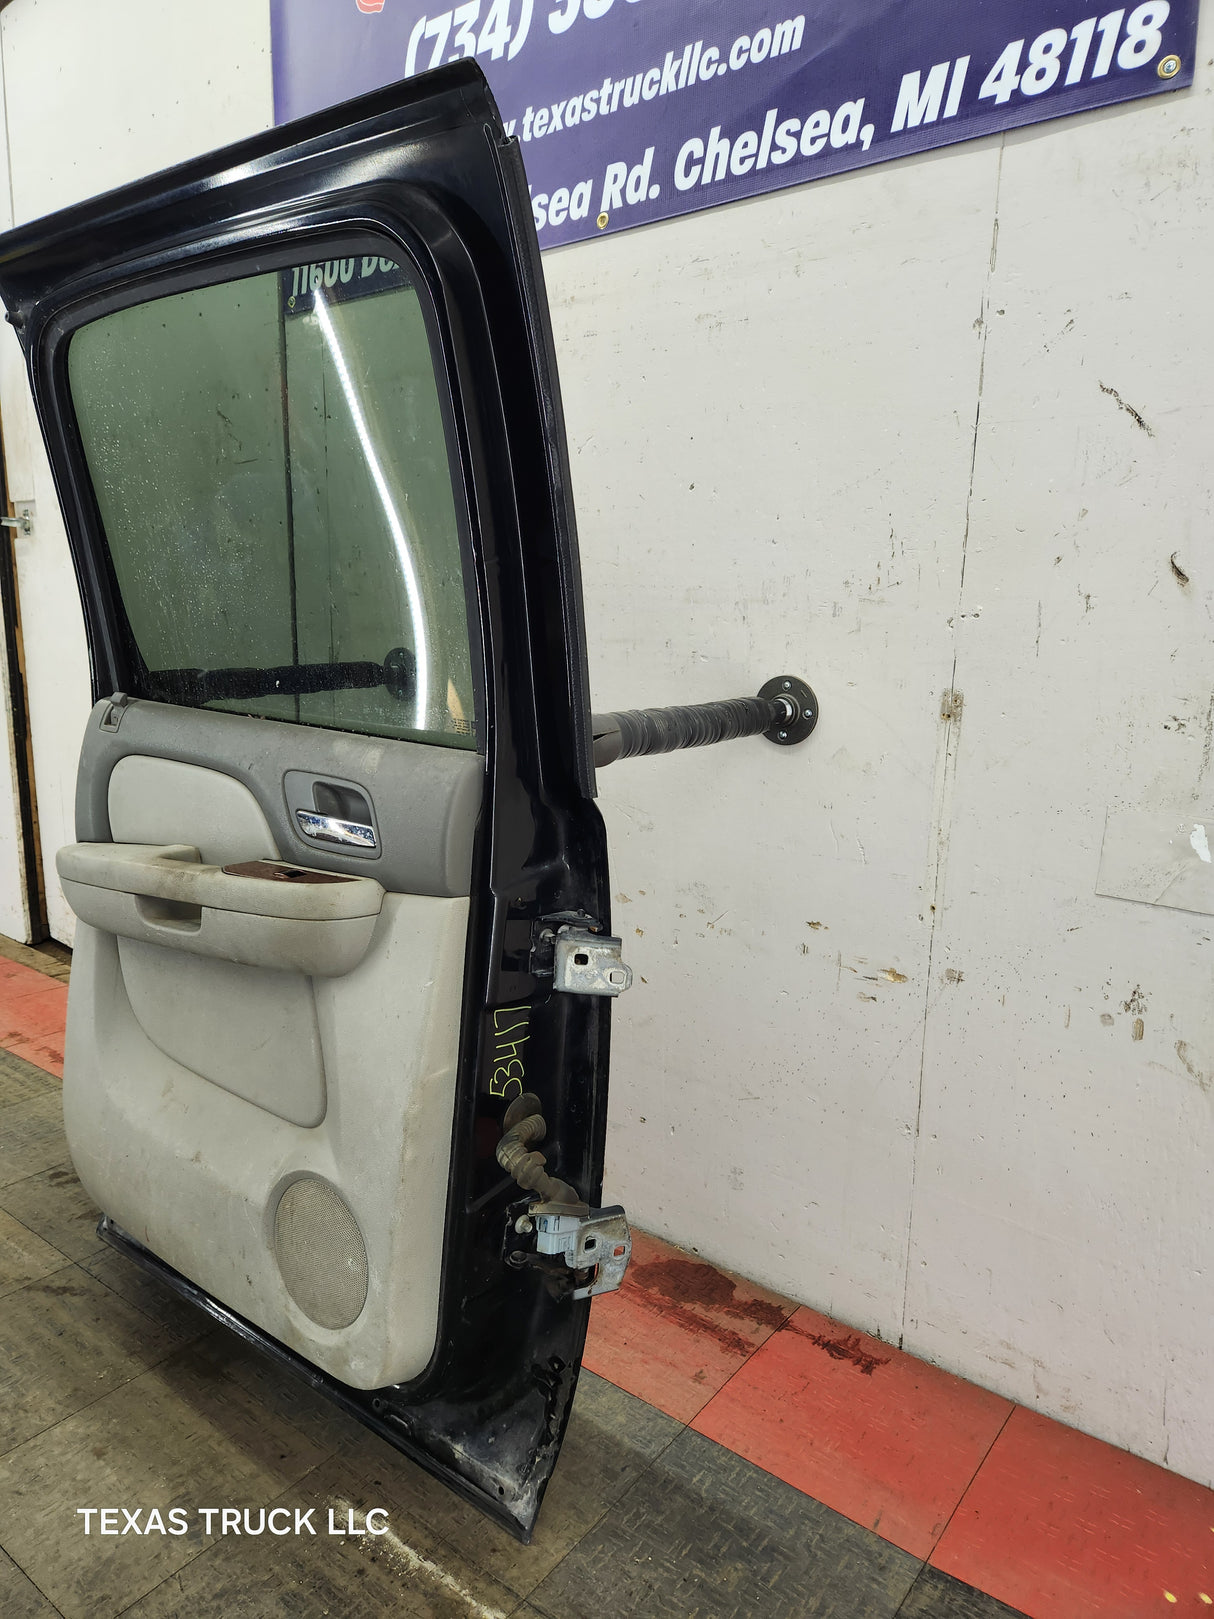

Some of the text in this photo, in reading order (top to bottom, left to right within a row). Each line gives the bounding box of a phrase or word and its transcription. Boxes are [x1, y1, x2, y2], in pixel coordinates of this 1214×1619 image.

[404, 0, 535, 79] (734)
[503, 14, 806, 144] texastruckllc.com
[291, 256, 355, 297] 11600
[527, 178, 594, 232] sea
[600, 146, 662, 213] Rd.
[674, 97, 876, 192] Chelsea,
[889, 54, 972, 134] MI
[977, 0, 1171, 105] 48118
[489, 1005, 532, 1098] 53417
